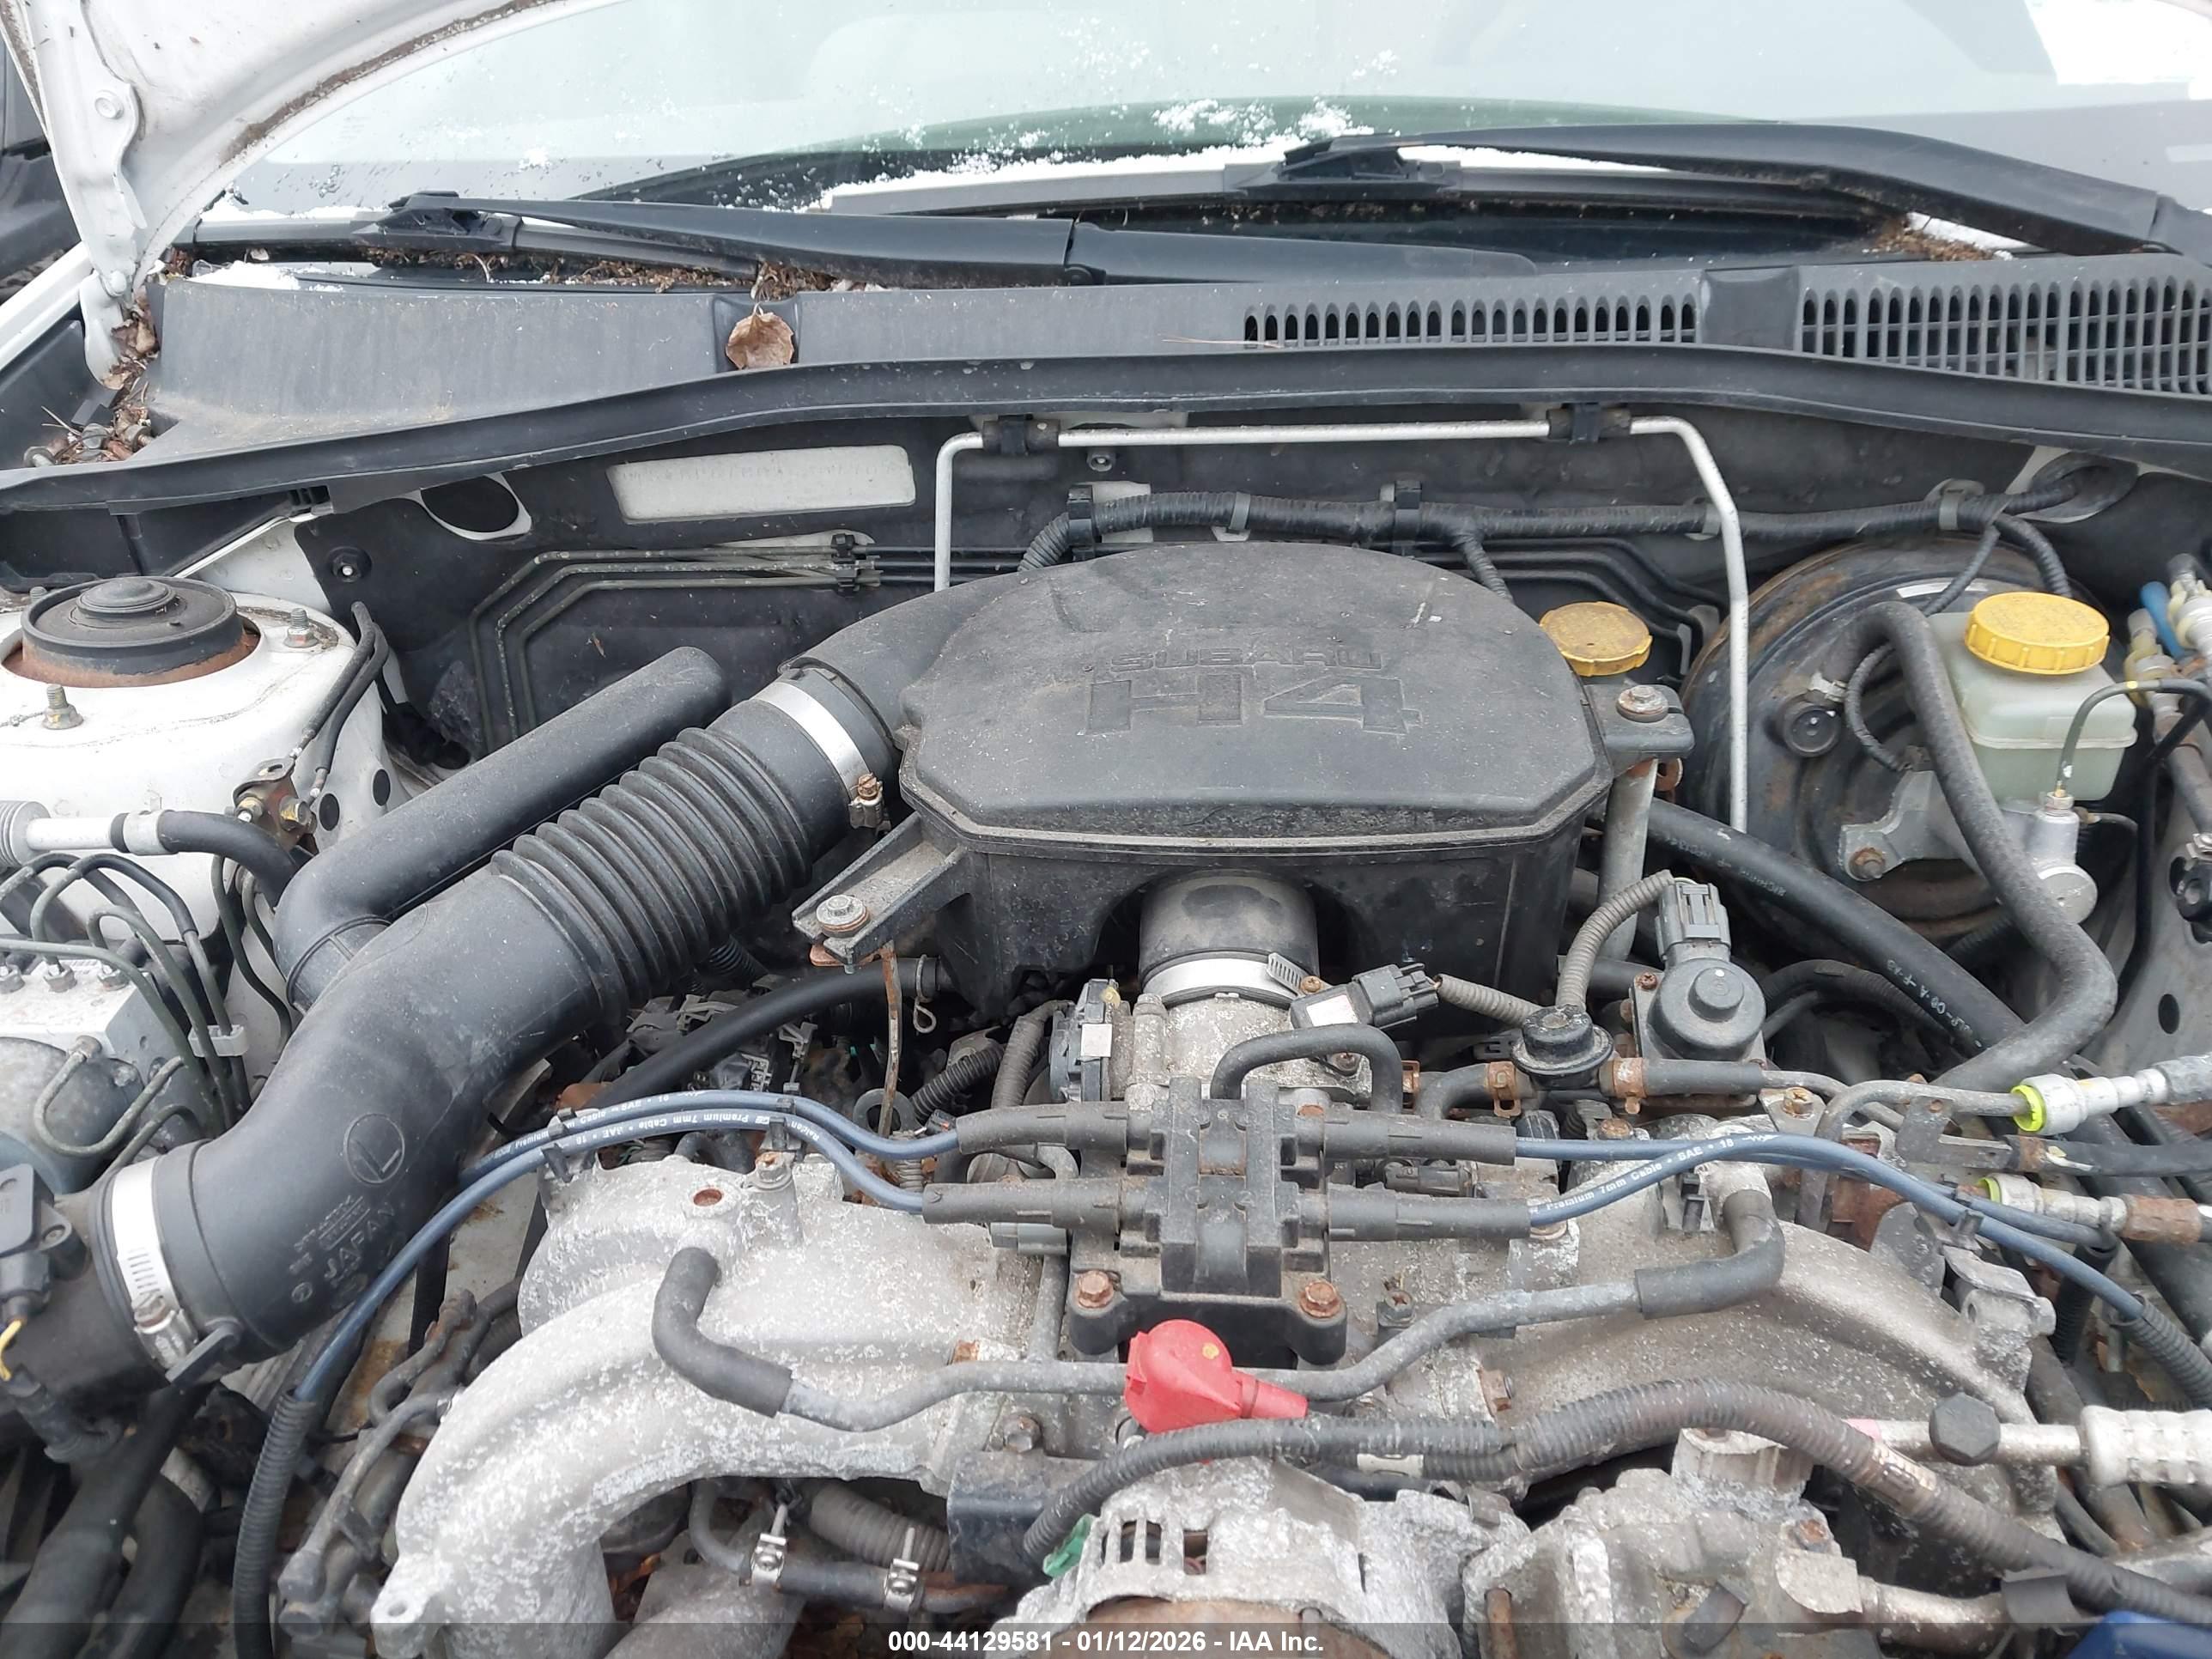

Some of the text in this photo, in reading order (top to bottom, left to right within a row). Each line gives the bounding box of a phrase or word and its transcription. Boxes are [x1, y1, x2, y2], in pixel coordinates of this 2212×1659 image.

[1109, 647, 1382, 674] SUBARU
[638, 1118, 667, 1128] Cable
[672, 1115, 698, 1124] 7mm
[703, 1114, 750, 1123] Premium
[1546, 1190, 1595, 1212] Premium
[1600, 1177, 1627, 1195] 7mm
[1632, 1162, 1663, 1182] Cable
[1677, 1145, 1704, 1163] SAE
[324, 1201, 395, 1279] JAPAN
